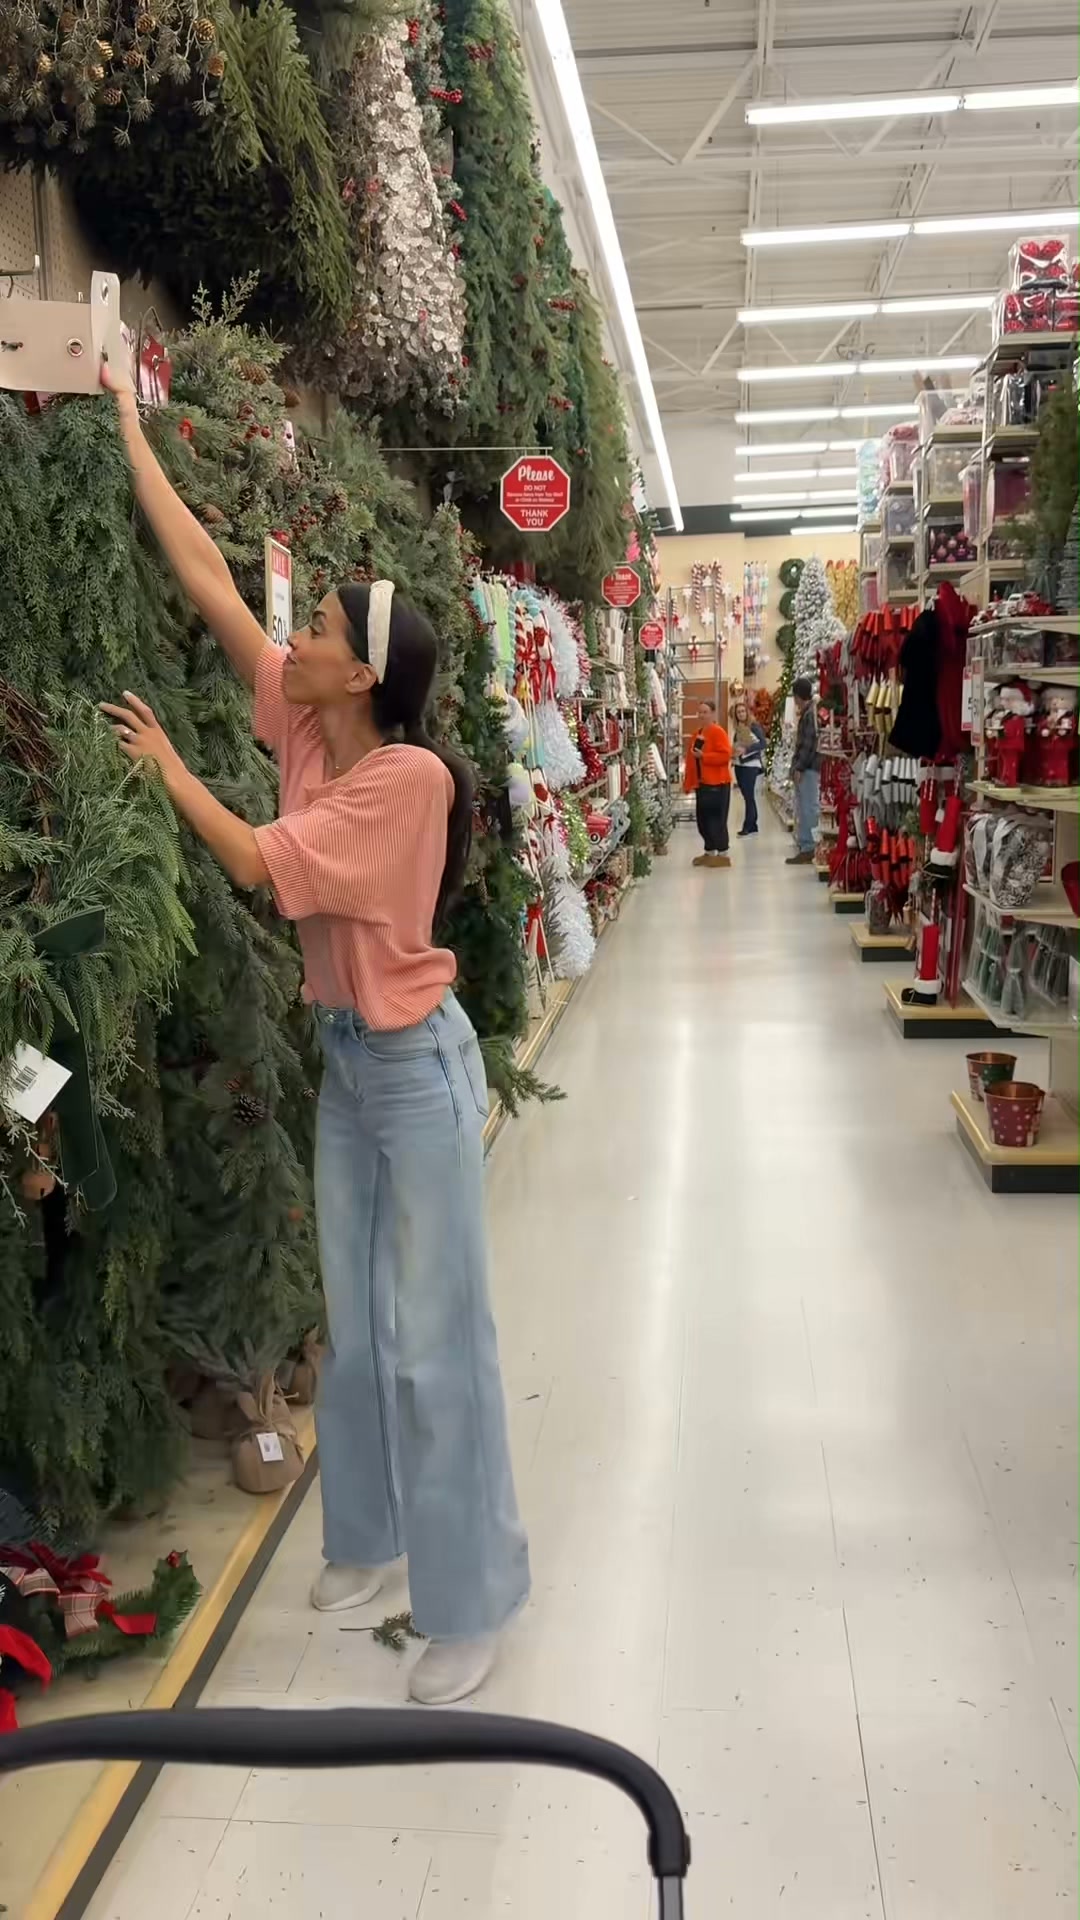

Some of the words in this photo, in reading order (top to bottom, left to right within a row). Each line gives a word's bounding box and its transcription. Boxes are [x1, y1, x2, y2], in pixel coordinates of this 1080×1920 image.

[518, 465, 555, 481] Please
[520, 509, 548, 517] THANK
[526, 518, 544, 526] YOU
